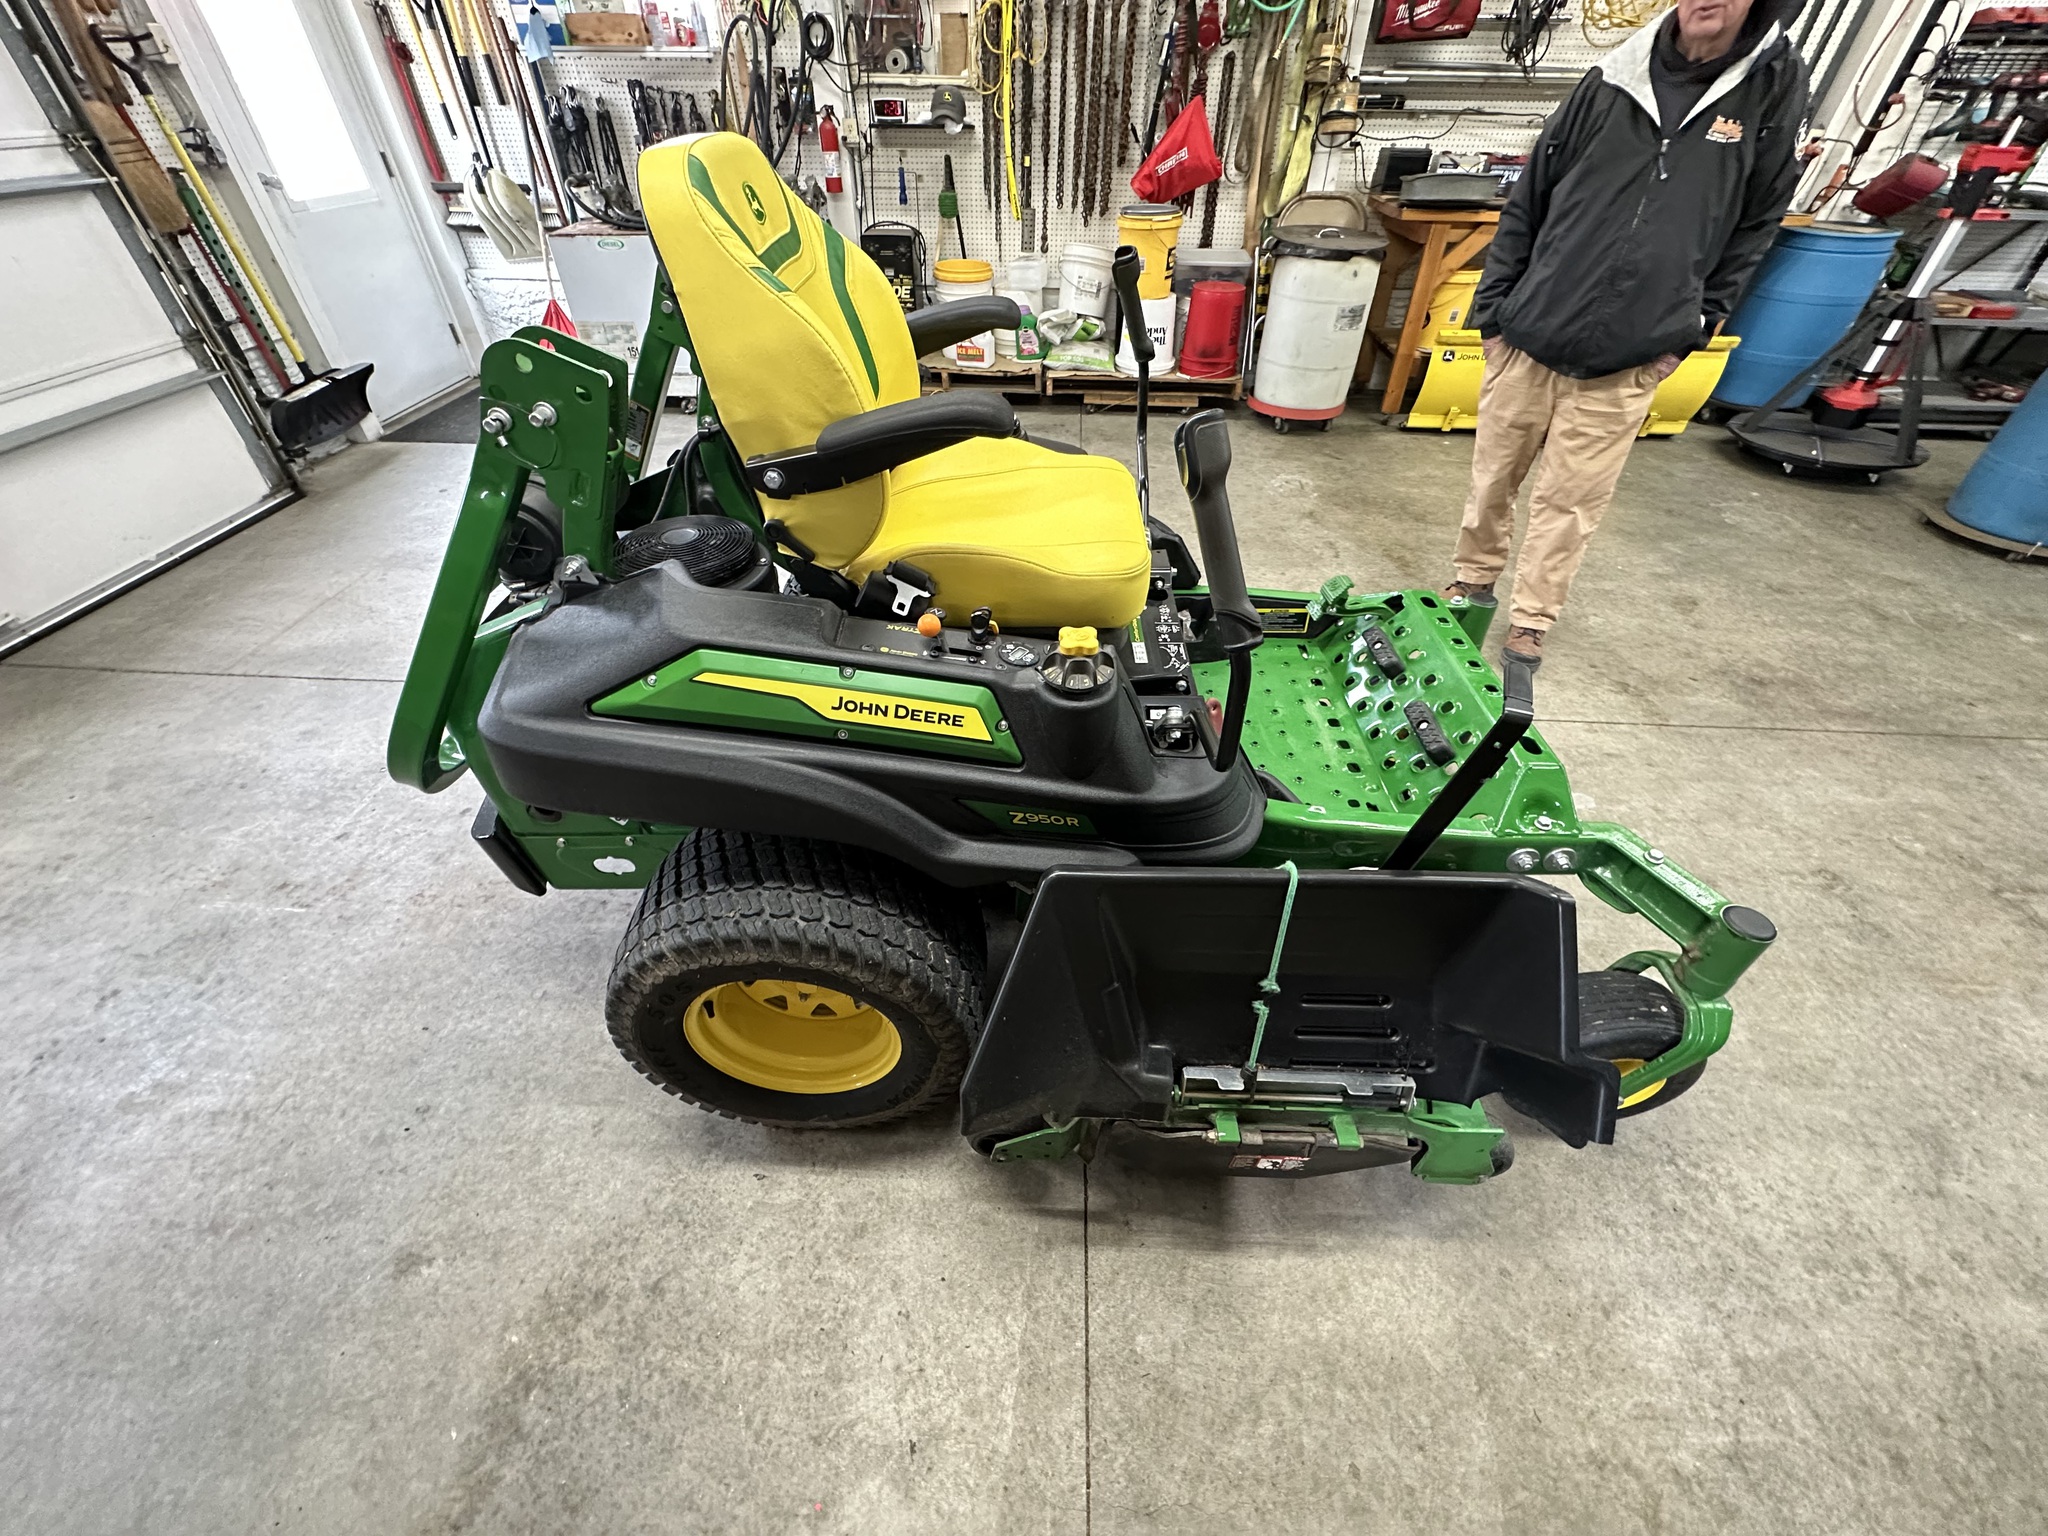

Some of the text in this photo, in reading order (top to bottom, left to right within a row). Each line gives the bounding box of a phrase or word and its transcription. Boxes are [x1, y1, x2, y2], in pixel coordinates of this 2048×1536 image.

[957, 347, 983, 356] ICE MELT
[1457, 353, 1481, 361] JOHN
[831, 696, 965, 728] JOHN DEERE
[1009, 812, 1080, 828] Z950R
